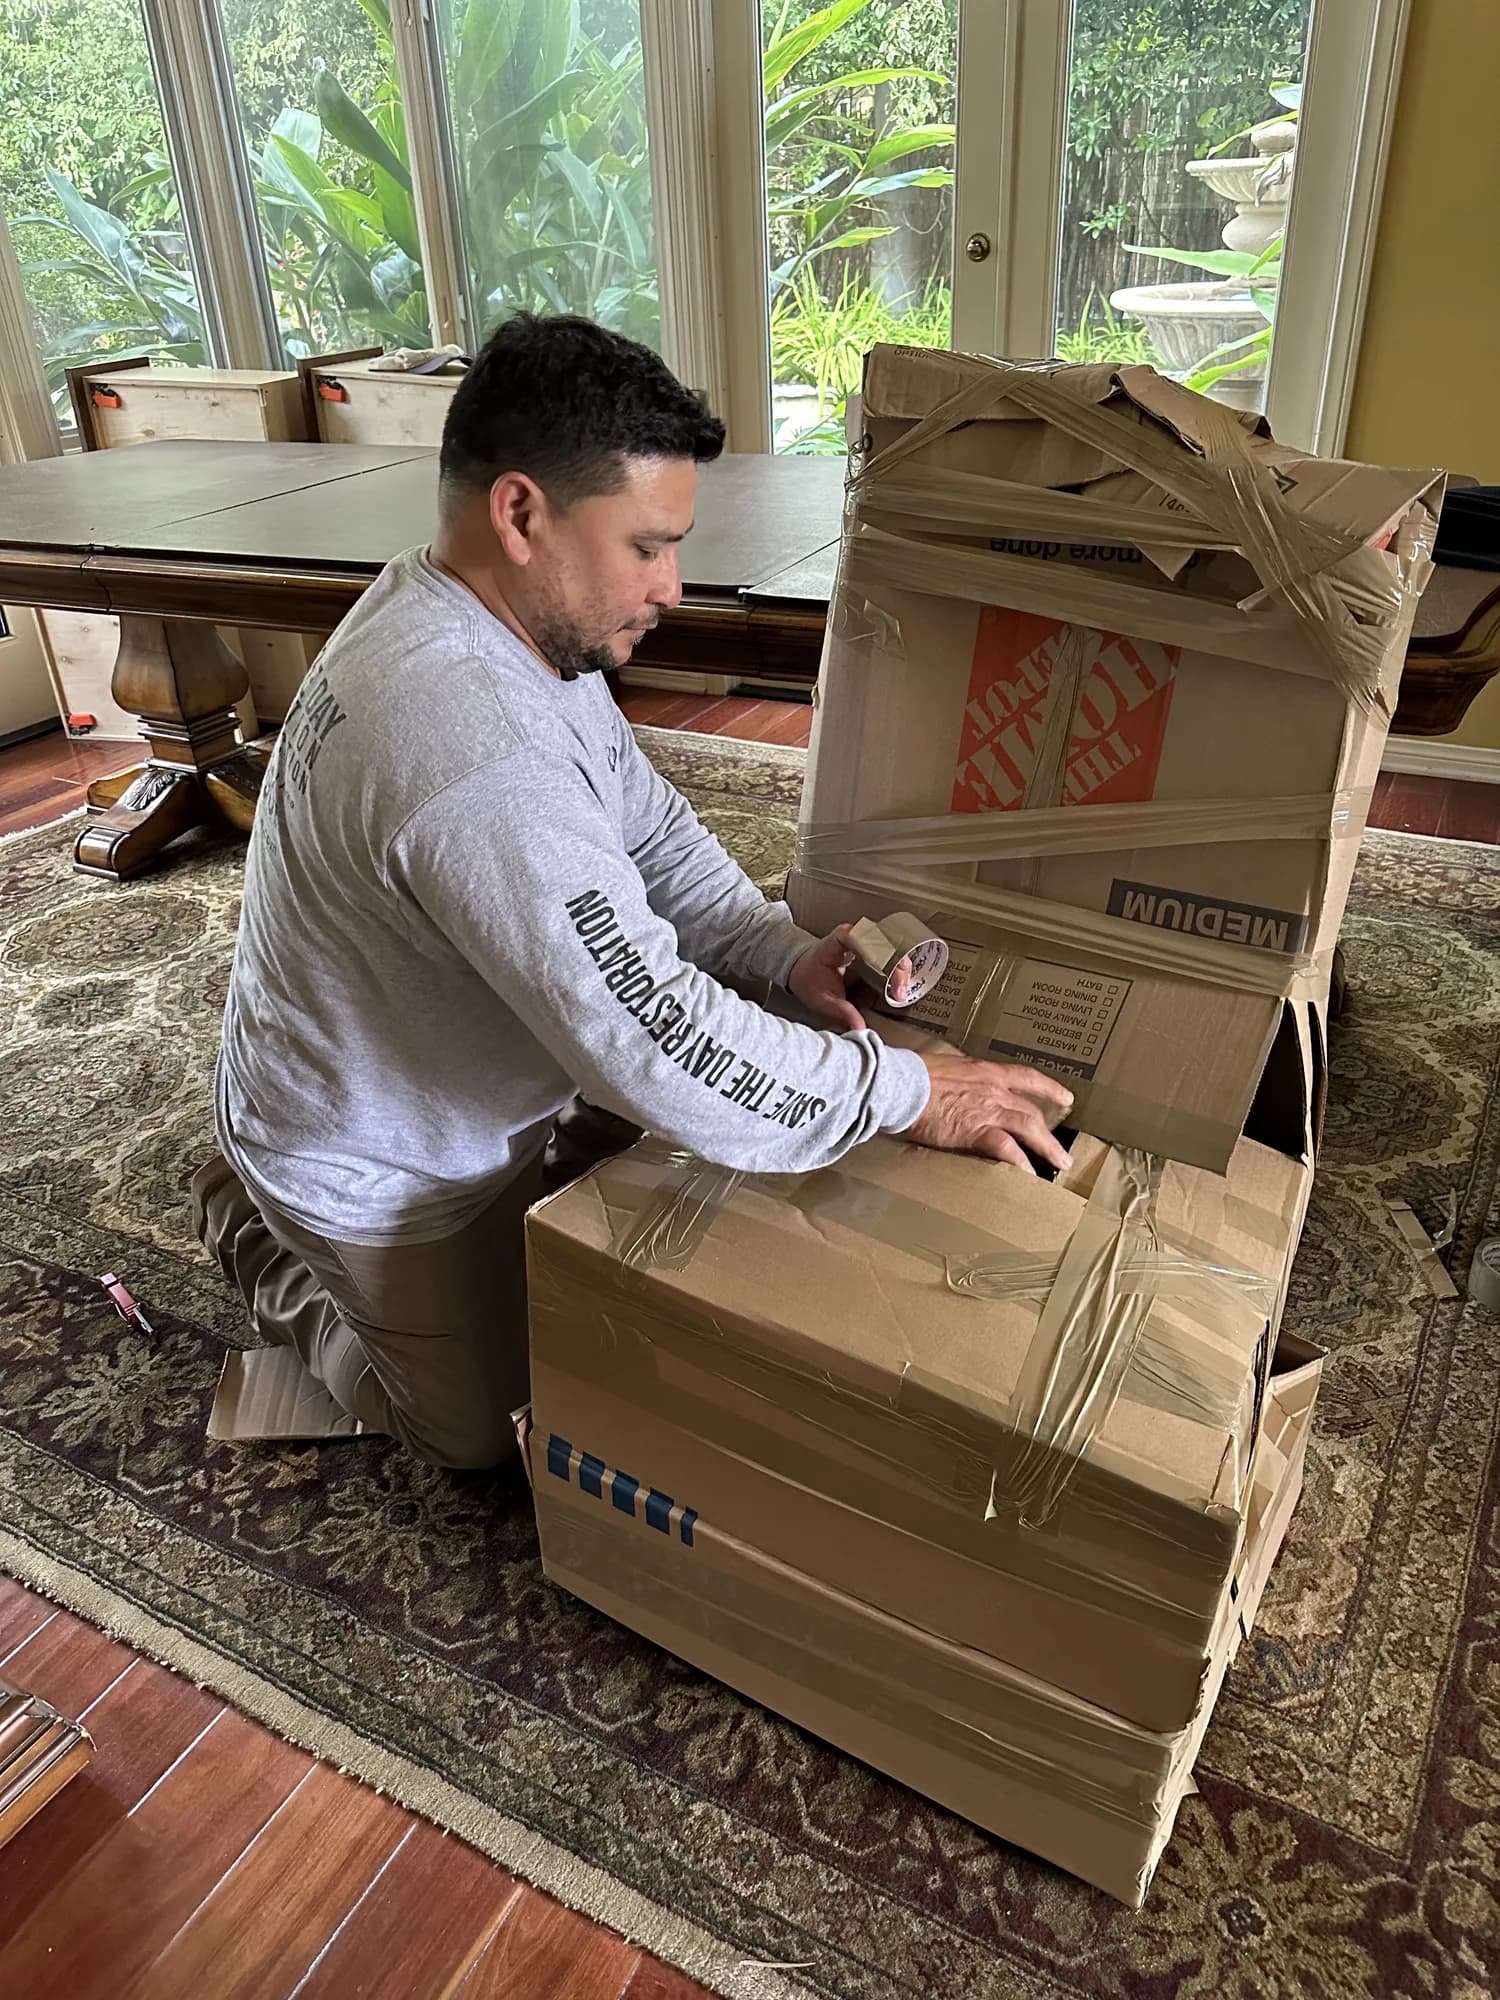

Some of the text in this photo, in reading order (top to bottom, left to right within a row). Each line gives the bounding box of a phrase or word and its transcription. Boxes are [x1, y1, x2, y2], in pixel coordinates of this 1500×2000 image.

[990, 537, 1060, 561] done
[305, 677, 346, 743] DAY
[1121, 890, 1290, 952] MEDIUM
[1032, 981, 1098, 1003] DINING ROOM
[1076, 978, 1103, 991] BATH
[564, 889, 827, 1130] SAVE THE DAY RESTORATION
[1022, 1004, 1088, 1028] FAMILY ROOM
[1029, 993, 1093, 1016] LIVING ROOM
[1032, 1020, 1083, 1040] BEDROOM
[1037, 1034, 1078, 1052] MASTER
[1038, 1057, 1083, 1077] PLACE
